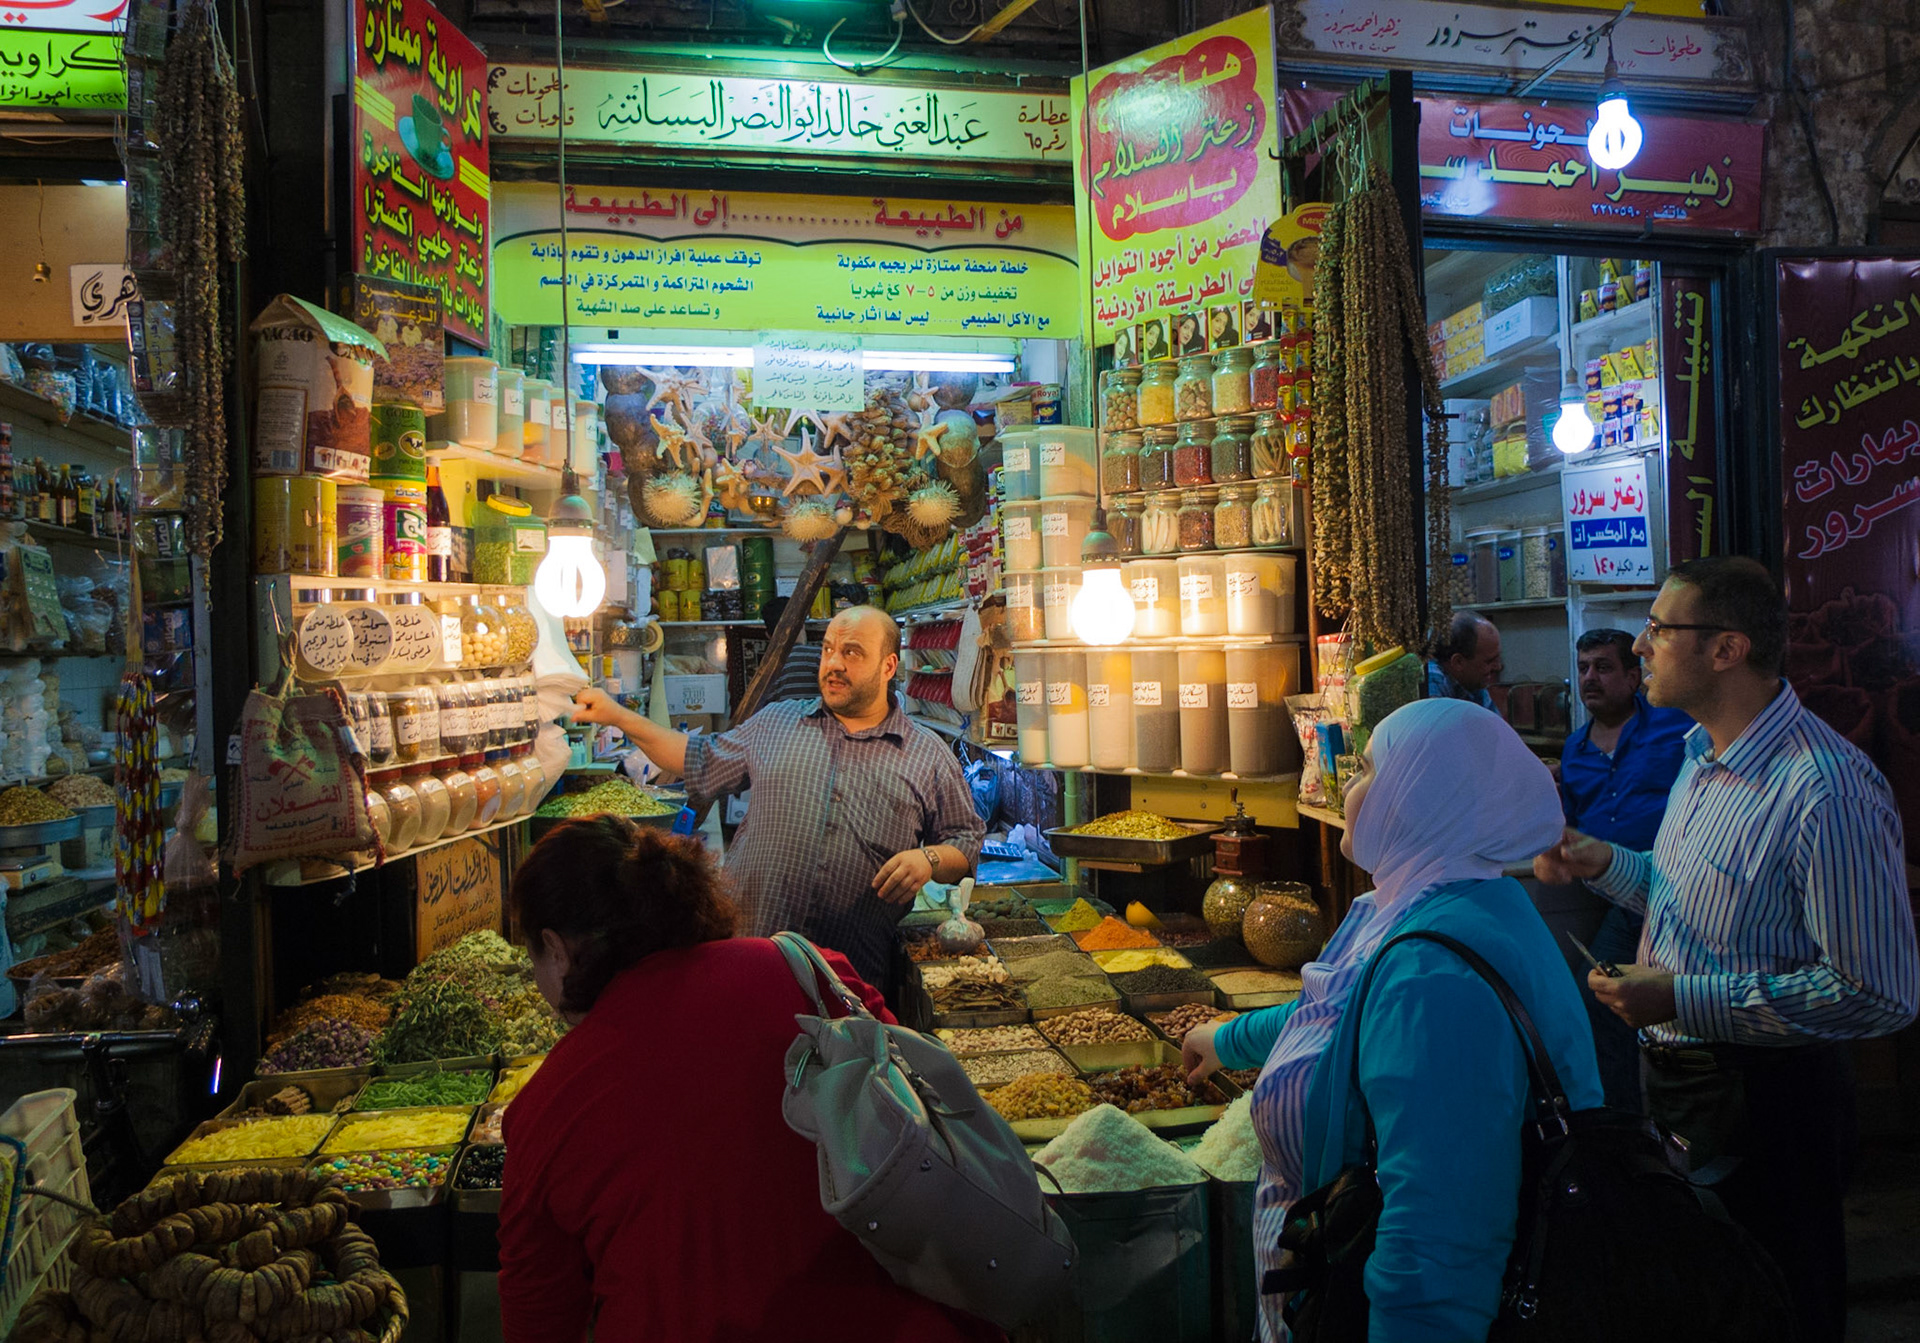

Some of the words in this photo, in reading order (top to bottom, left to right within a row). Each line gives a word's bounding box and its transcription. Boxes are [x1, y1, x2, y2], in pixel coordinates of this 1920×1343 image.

[1427, 20, 1517, 48] سرور
[0, 39, 125, 78] كراوي
[426, 19, 481, 140] كراوية
[810, 86, 883, 138] خالد
[876, 92, 940, 151] الغني
[1018, 99, 1071, 126] عطارة
[929, 103, 989, 151] عبد
[1024, 131, 1042, 151] ٦٥
[1187, 103, 1256, 163] زعتر
[363, 131, 429, 200] الفاخرة
[1093, 122, 1183, 198] السلام
[1605, 156, 1734, 208] زهير
[431, 183, 484, 244] ولوازمها
[564, 185, 687, 224] الطبيعة
[995, 209, 1023, 238] من
[1213, 217, 1267, 258] المحضر
[417, 230, 452, 262] حلبي
[612, 248, 652, 266] الدهون
[689, 248, 722, 267] عملية
[724, 250, 762, 268] توقف
[1188, 237, 1208, 266] من
[455, 243, 484, 287] زعتر
[927, 257, 961, 274] ممتازة
[1000, 260, 1029, 274] خلطة
[1095, 250, 1144, 288] التوابل
[581, 275, 594, 293] في
[940, 287, 954, 301] من
[957, 288, 976, 302] وزن
[978, 286, 1018, 300] تخفيف
[1156, 271, 1233, 312] الطريقة
[454, 285, 484, 332] بهارات
[643, 303, 667, 317] على
[670, 302, 710, 316] تساعد
[884, 310, 901, 323] لها
[905, 311, 929, 325] ليس
[1037, 316, 1050, 330] مع
[1569, 488, 1606, 516] سرور
[1609, 473, 1644, 513] زعتر
[1573, 520, 1628, 547] المكسرات
[1630, 526, 1645, 546] مع
[1593, 553, 1614, 576] ١٤٠
